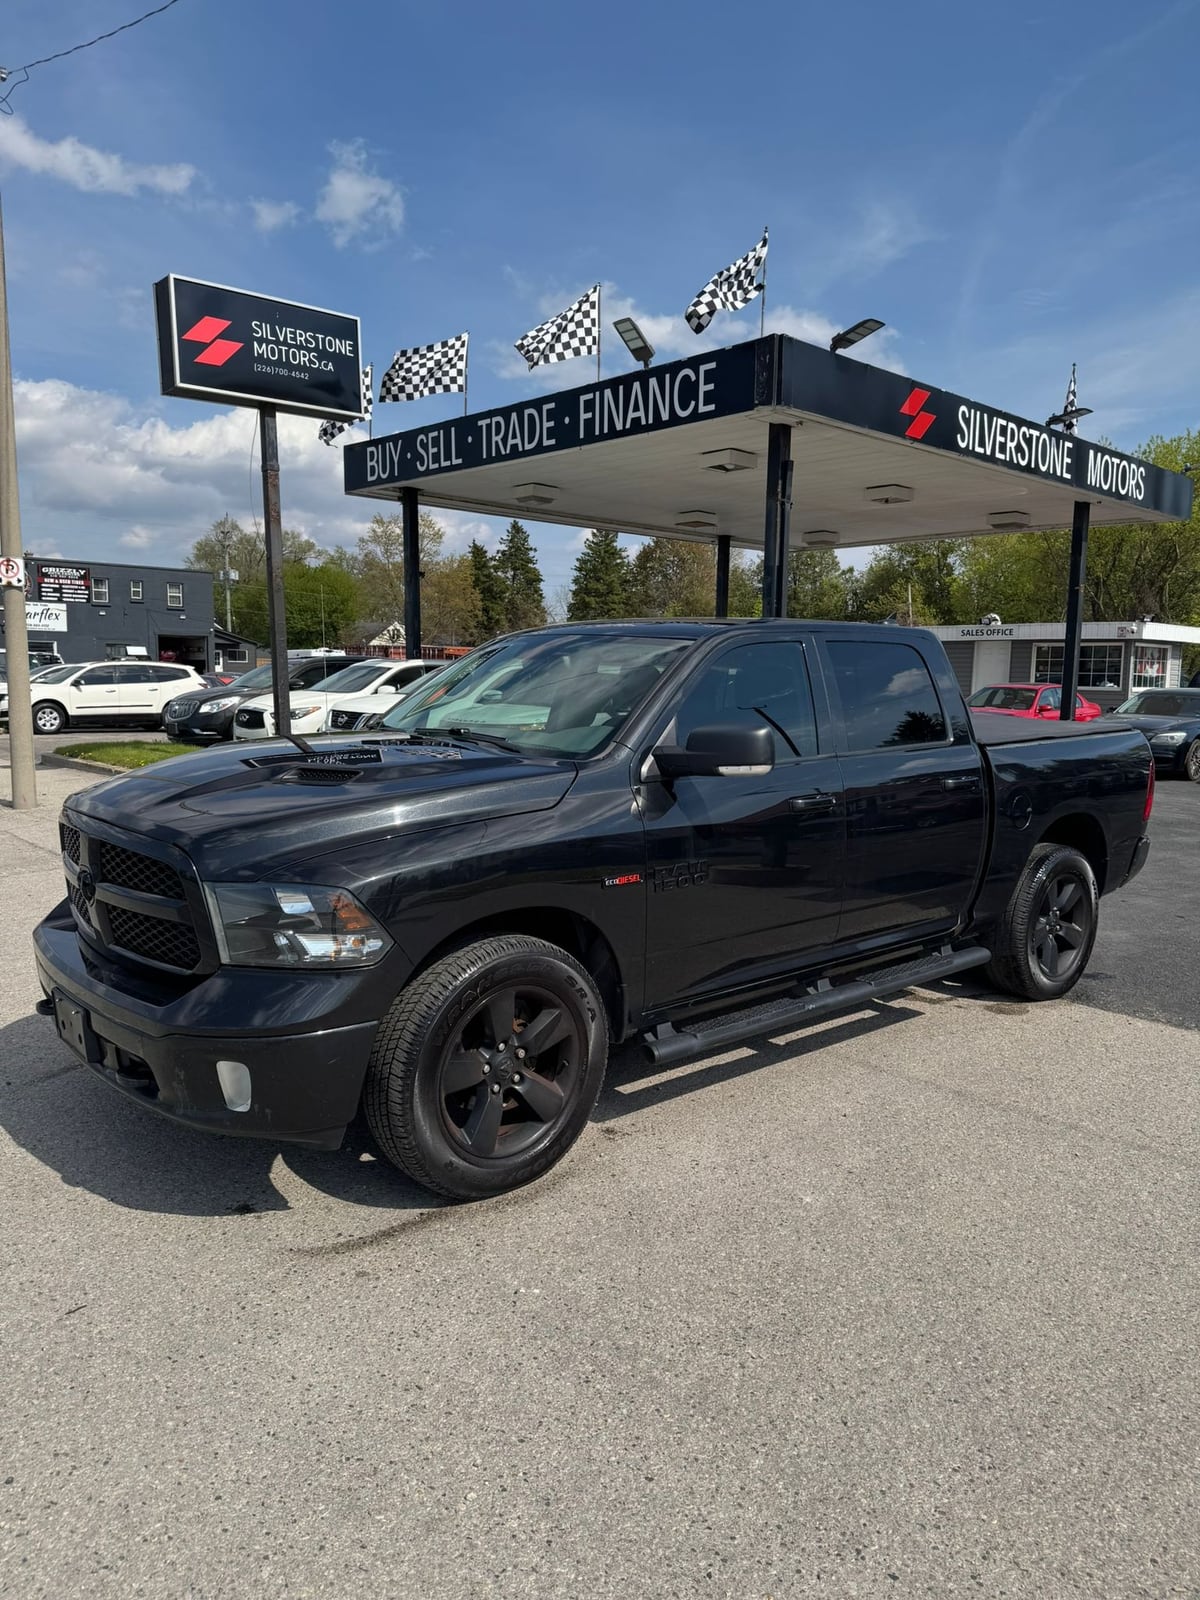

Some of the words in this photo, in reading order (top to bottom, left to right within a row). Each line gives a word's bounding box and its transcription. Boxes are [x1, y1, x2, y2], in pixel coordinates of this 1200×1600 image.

[252, 320, 354, 357] SILVERSTONE
[254, 363, 310, 380] (226)700-4542
[366, 440, 402, 482] BUY
[416, 426, 463, 472] SELL
[477, 402, 556, 457] TRADE
[579, 361, 718, 439] FINANCE
[956, 404, 1074, 480] SILVERSTONE
[1087, 449, 1146, 500] MOTORS
[41, 567, 86, 575] GRIZZLY
[26, 608, 61, 623] arflex
[961, 629, 985, 637] SALES
[986, 628, 1014, 637] OFFICE
